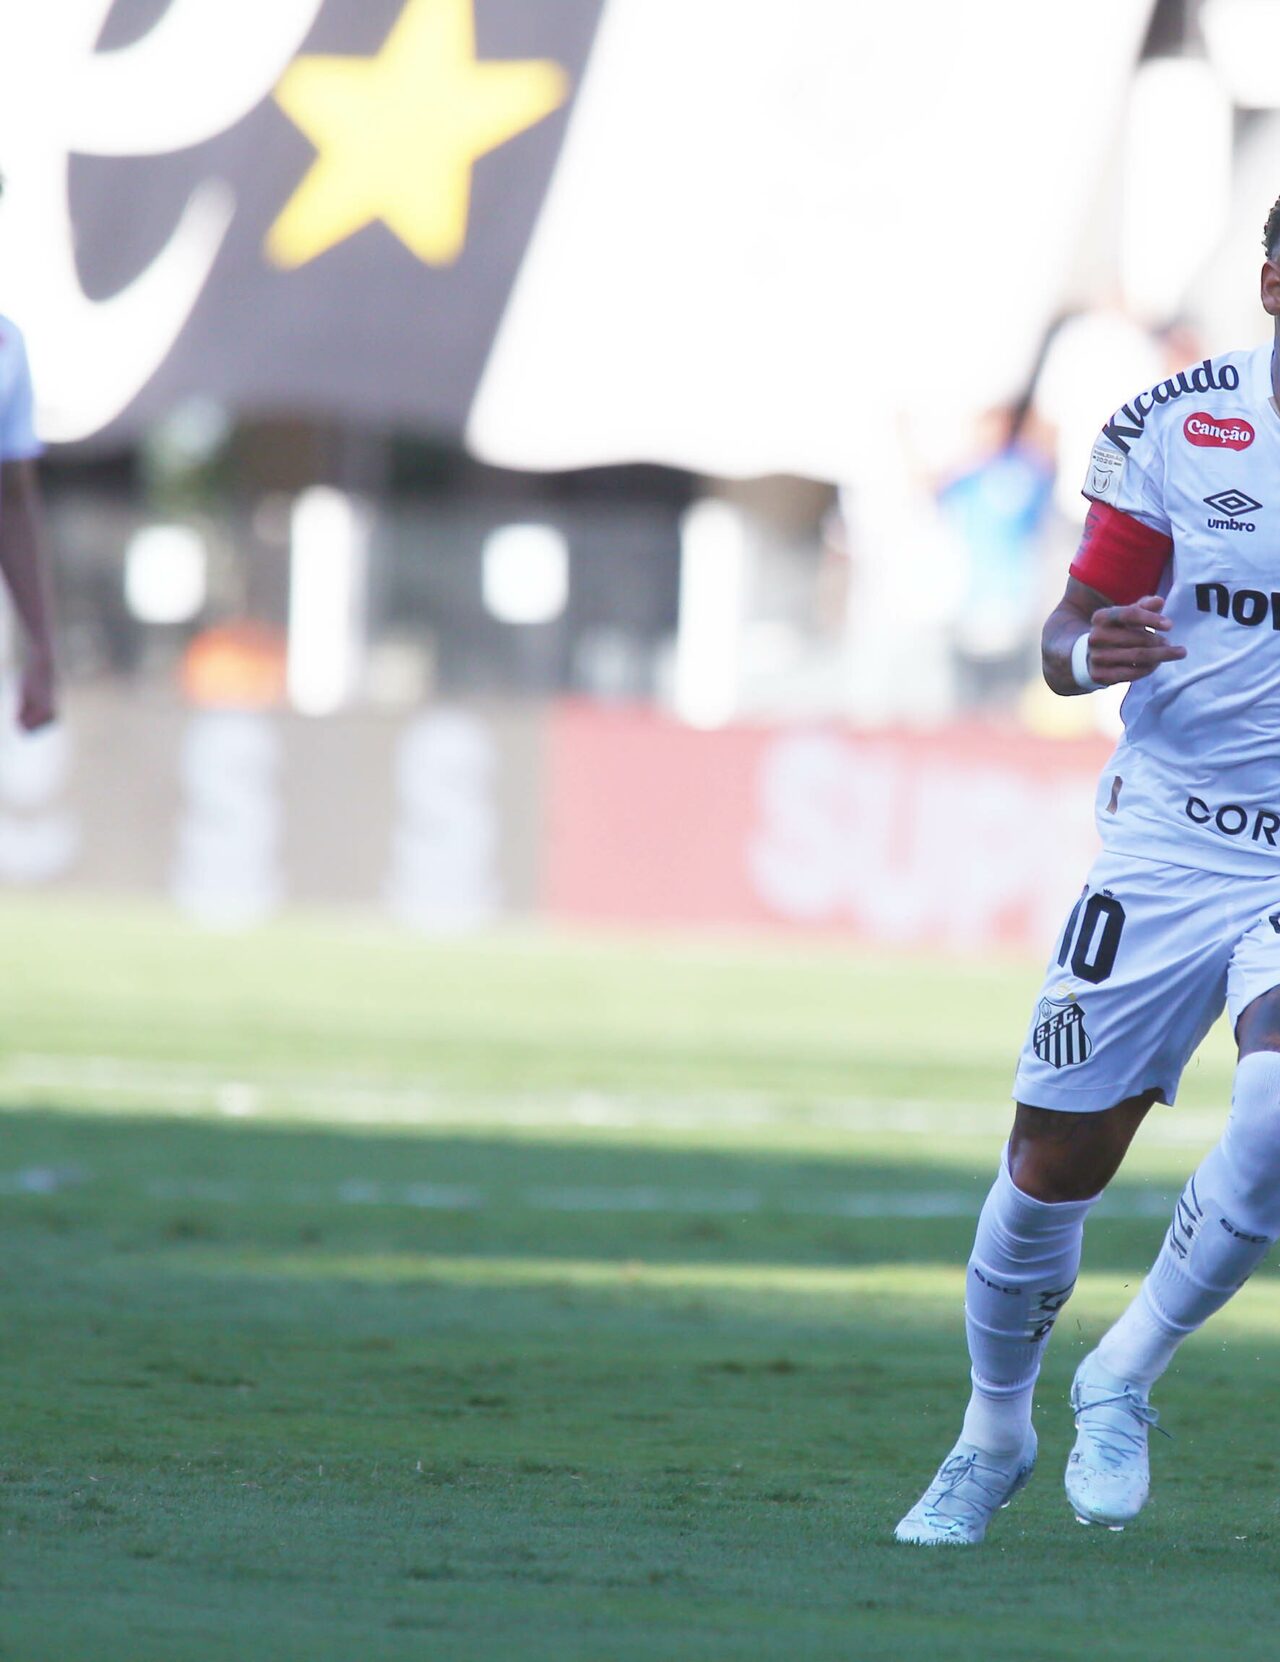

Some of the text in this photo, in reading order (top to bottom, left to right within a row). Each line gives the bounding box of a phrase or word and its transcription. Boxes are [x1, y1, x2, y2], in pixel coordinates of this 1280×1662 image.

[1187, 418, 1252, 444] Canção
[1207, 517, 1257, 533] umbro
[1057, 883, 1126, 985] 10
